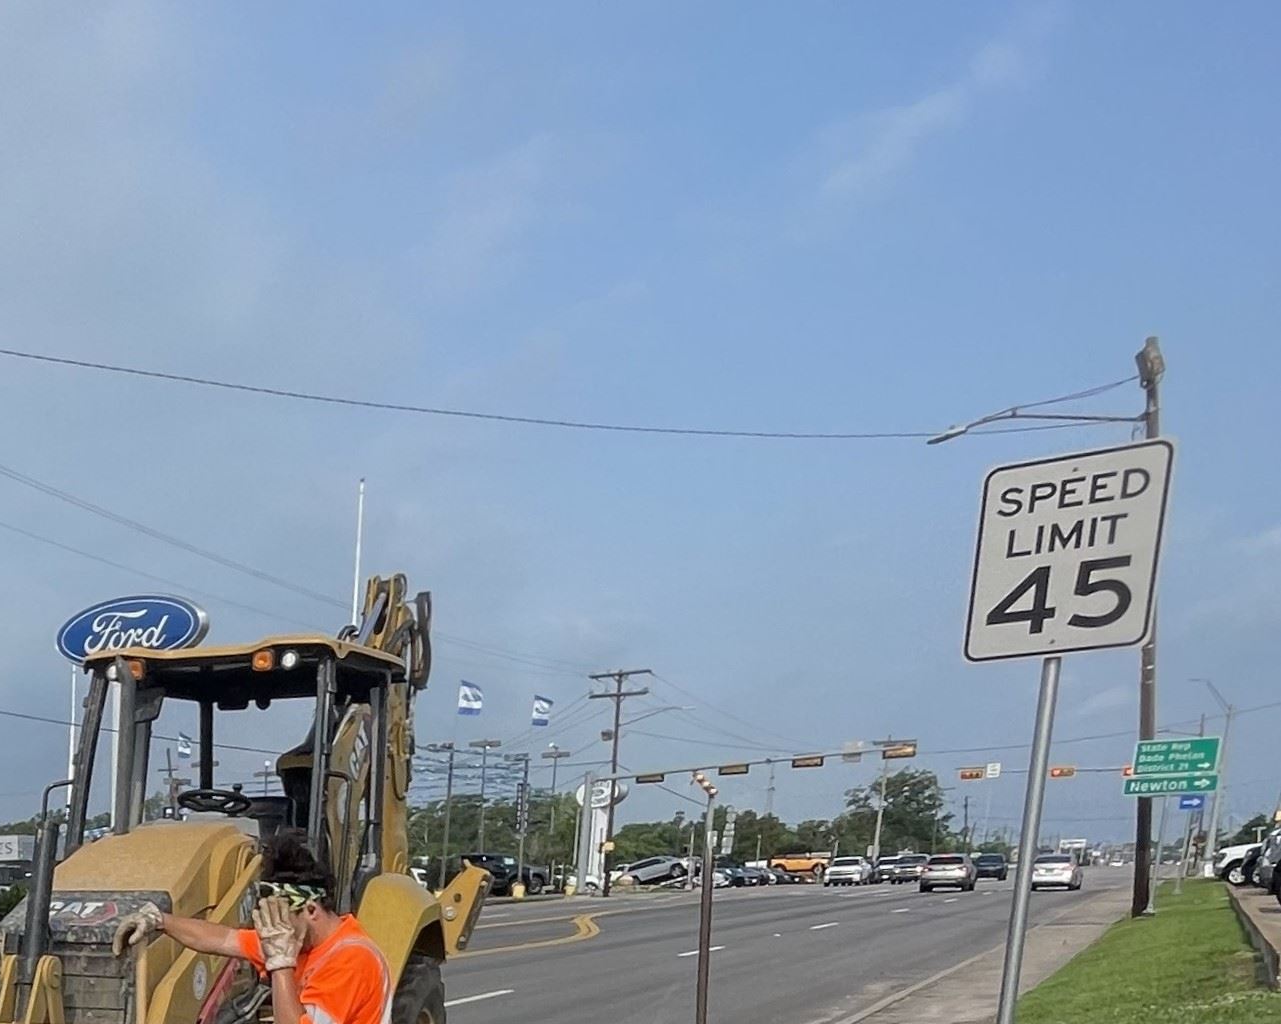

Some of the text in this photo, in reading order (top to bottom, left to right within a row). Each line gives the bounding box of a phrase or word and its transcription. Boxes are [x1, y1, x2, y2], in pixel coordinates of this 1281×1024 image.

[996, 468, 1151, 517] SPEED
[1006, 513, 1129, 559] LIMIT
[985, 554, 1133, 635] 45
[83, 609, 169, 654] Ford
[1129, 780, 1188, 792] Newton
